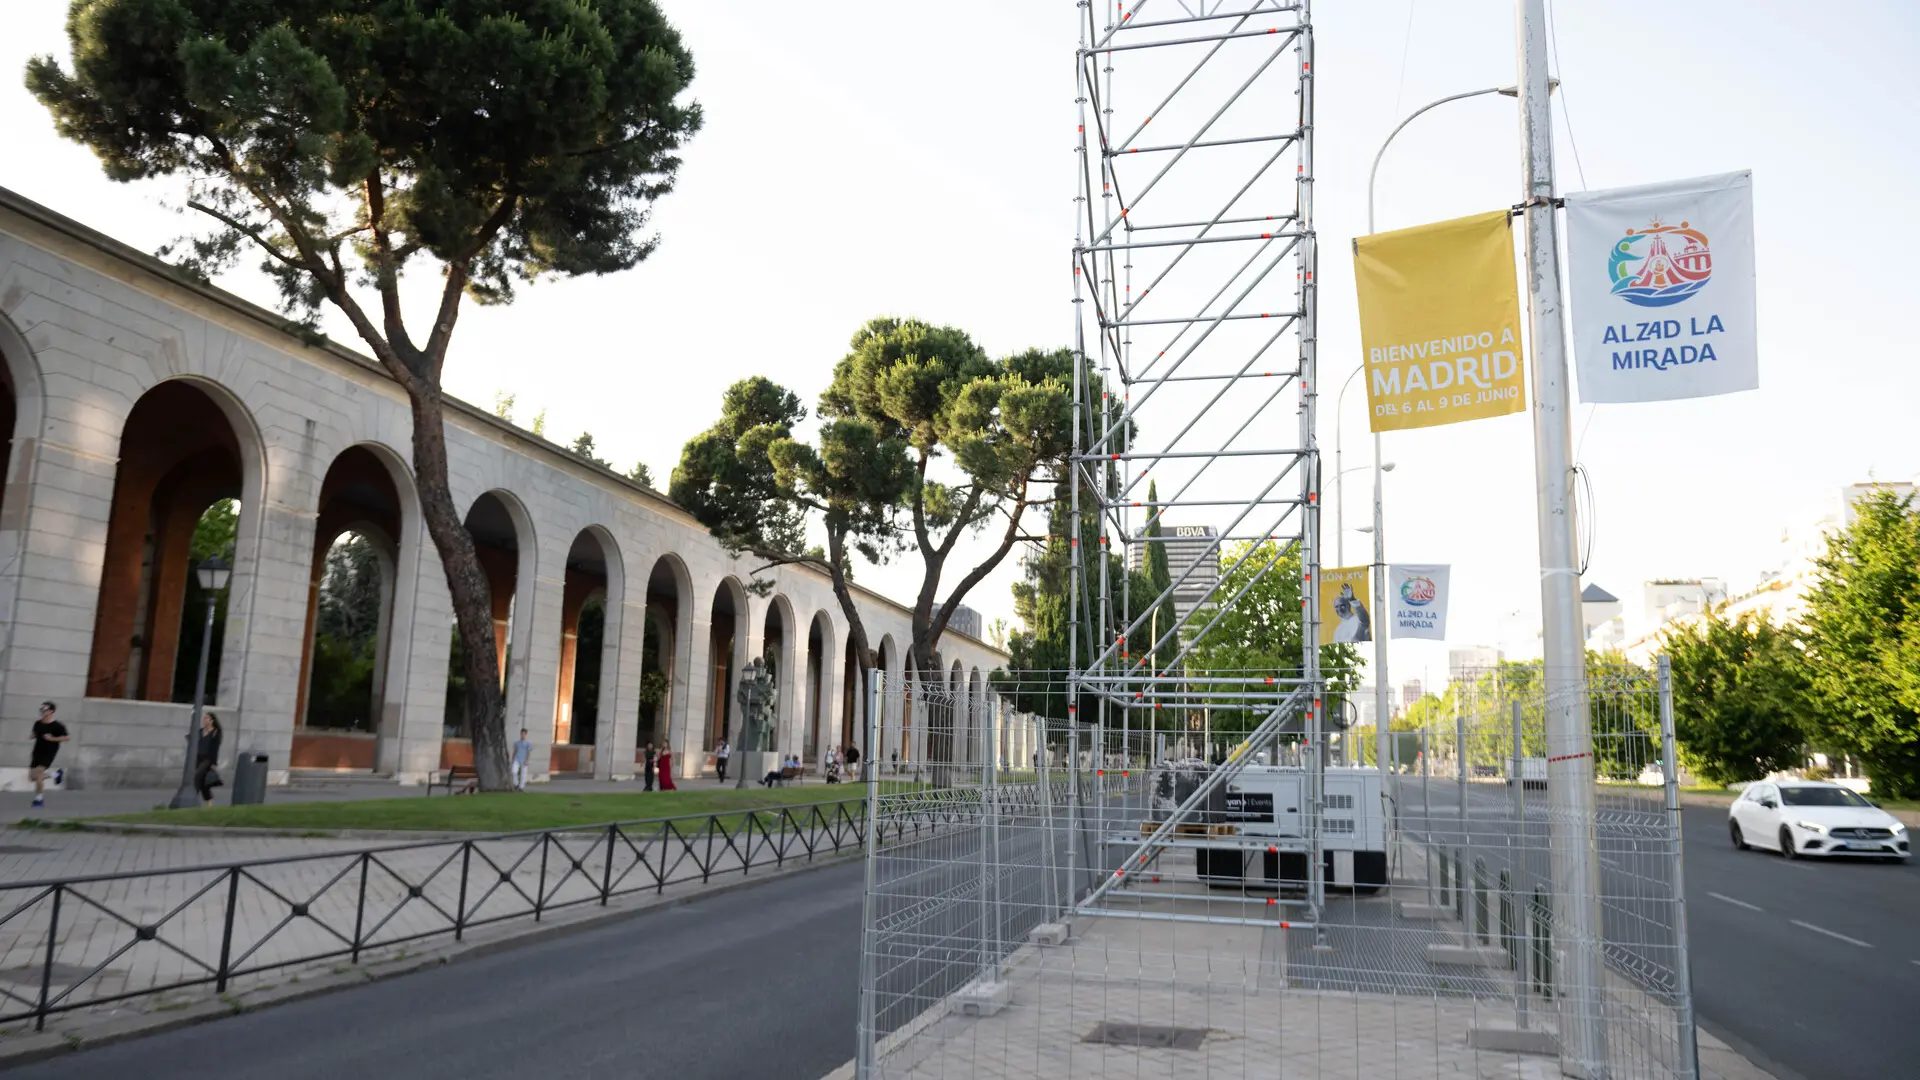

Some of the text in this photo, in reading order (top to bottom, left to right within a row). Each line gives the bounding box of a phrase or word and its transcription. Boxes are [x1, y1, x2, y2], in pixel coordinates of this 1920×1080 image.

[1602, 315, 1725, 344] ALZAD LA
[1370, 328, 1514, 364] BIENVENIDO A
[1612, 343, 1717, 370] MIRADA
[1372, 351, 1517, 396] MADRID
[1375, 386, 1519, 416] DEL 6 AL 9 DE JUNIO
[1176, 526, 1206, 537] BBVA
[1397, 610, 1437, 619] ALZAD LA
[1400, 620, 1433, 629] MIRADA
